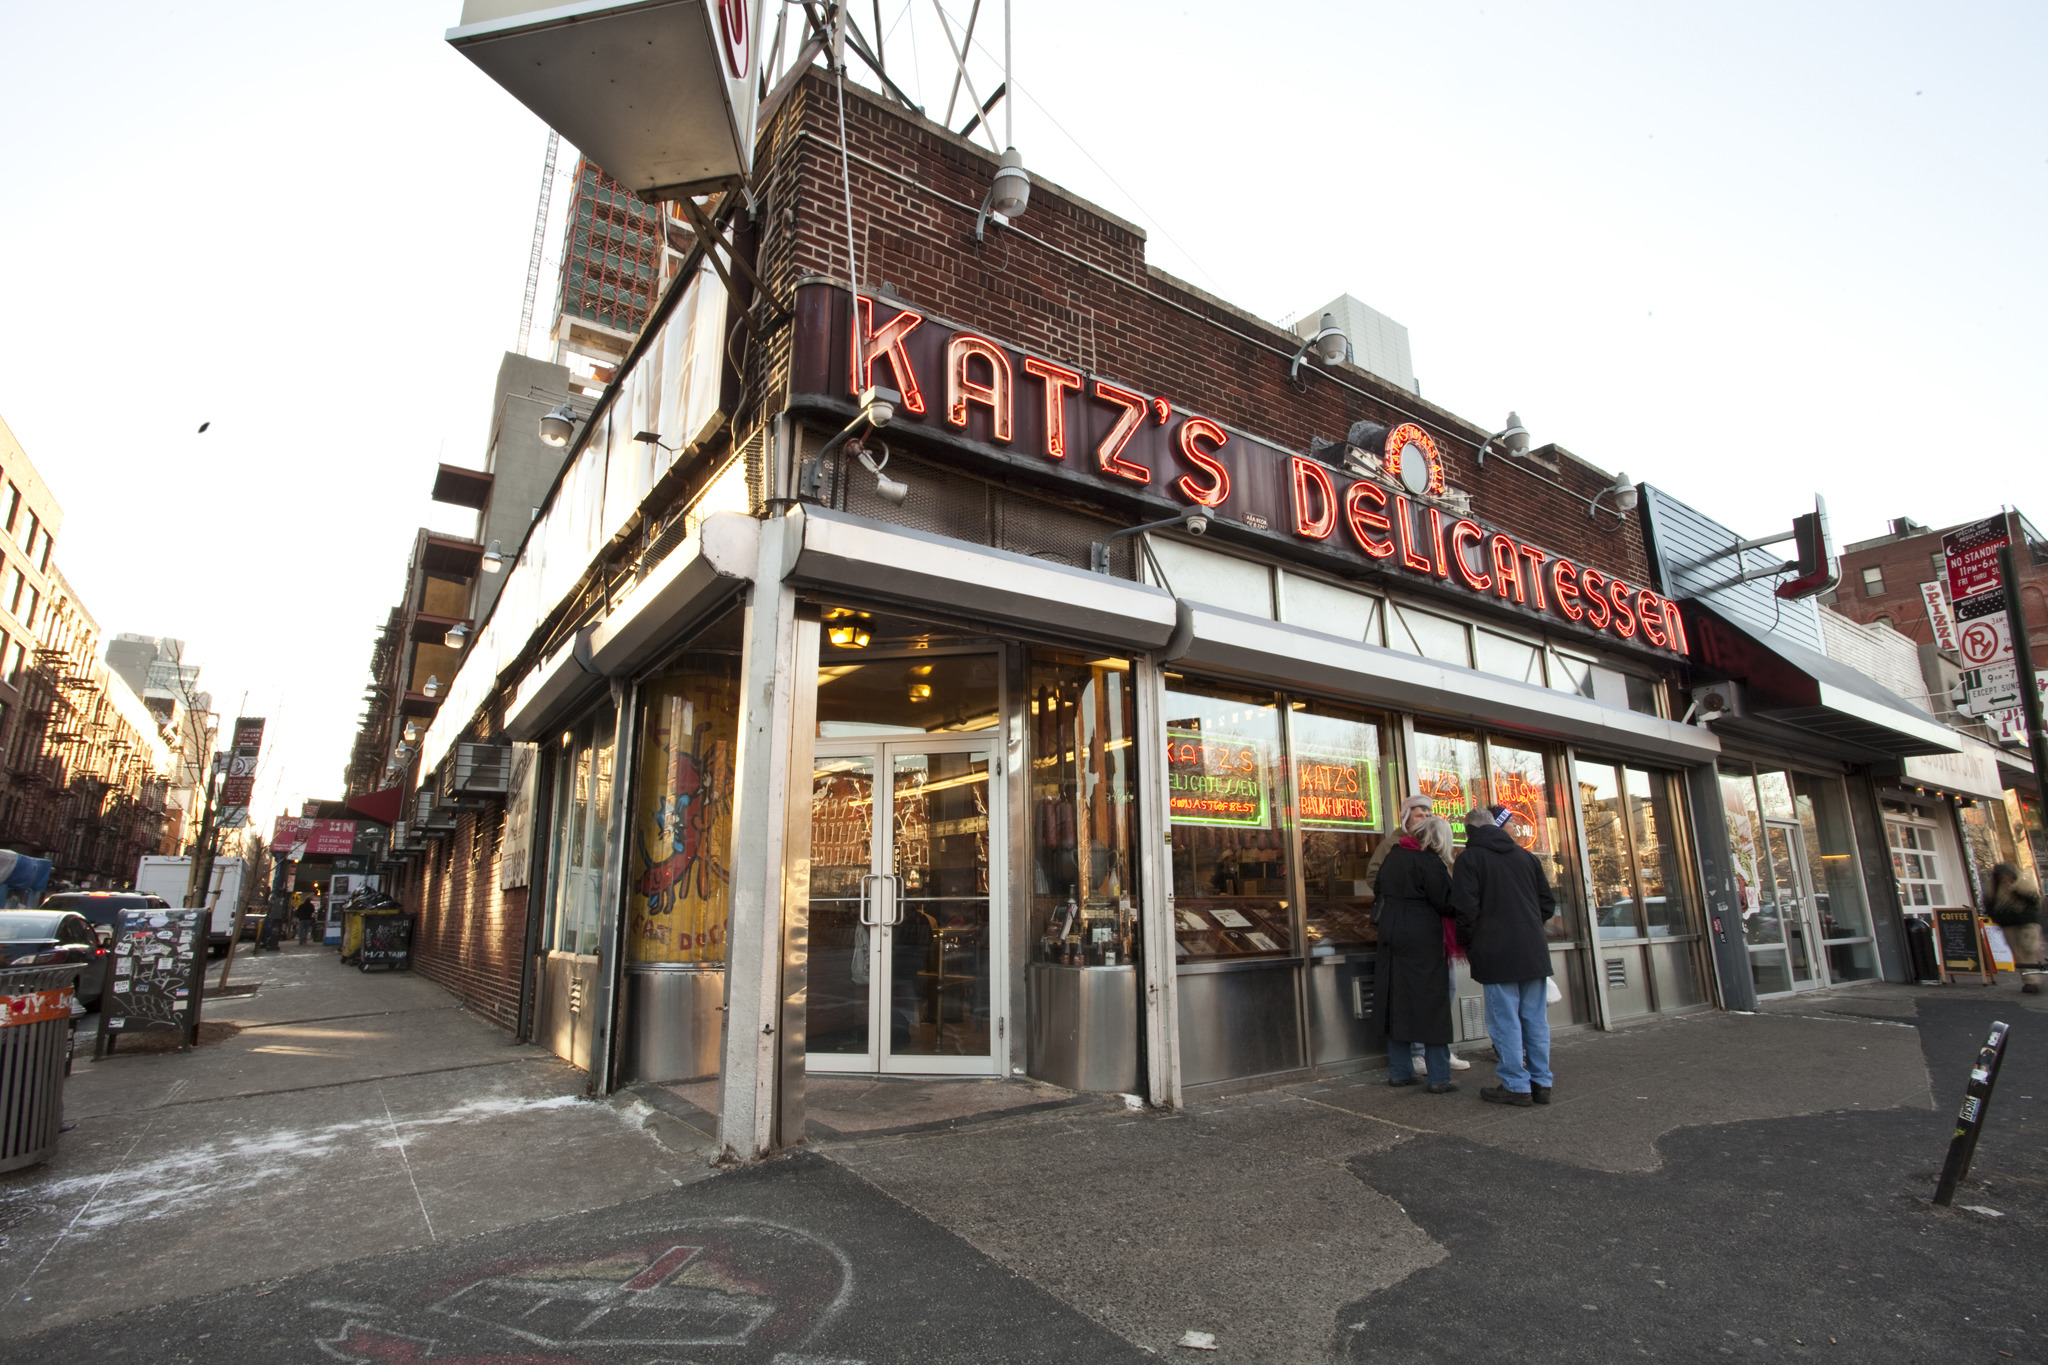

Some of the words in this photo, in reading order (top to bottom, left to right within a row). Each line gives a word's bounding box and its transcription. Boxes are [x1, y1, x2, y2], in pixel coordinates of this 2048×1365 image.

[850, 296, 1231, 508] KATZ'S
[1955, 525, 1976, 538] SPECIAL
[1976, 520, 1992, 529] NIGHT
[1959, 528, 1990, 542] REGULATION
[1289, 456, 1690, 656] DELICATESSEN
[1951, 558, 1962, 568] NO
[1958, 578, 1968, 587] FRI
[1973, 572, 1987, 581] THRU
[1961, 598, 1976, 606] NIGHT
[1978, 589, 2004, 602] REGULATI
[1926, 591, 1956, 650] PIZZA
[1973, 686, 1997, 698] EXCEPT
[2002, 681, 2020, 692] SUND
[1169, 773, 1257, 797] ELICATESSEN
[1301, 764, 1358, 793] KATZ'S
[1418, 770, 1460, 797] ATZ'S
[1941, 912, 1969, 921] COFFEE
